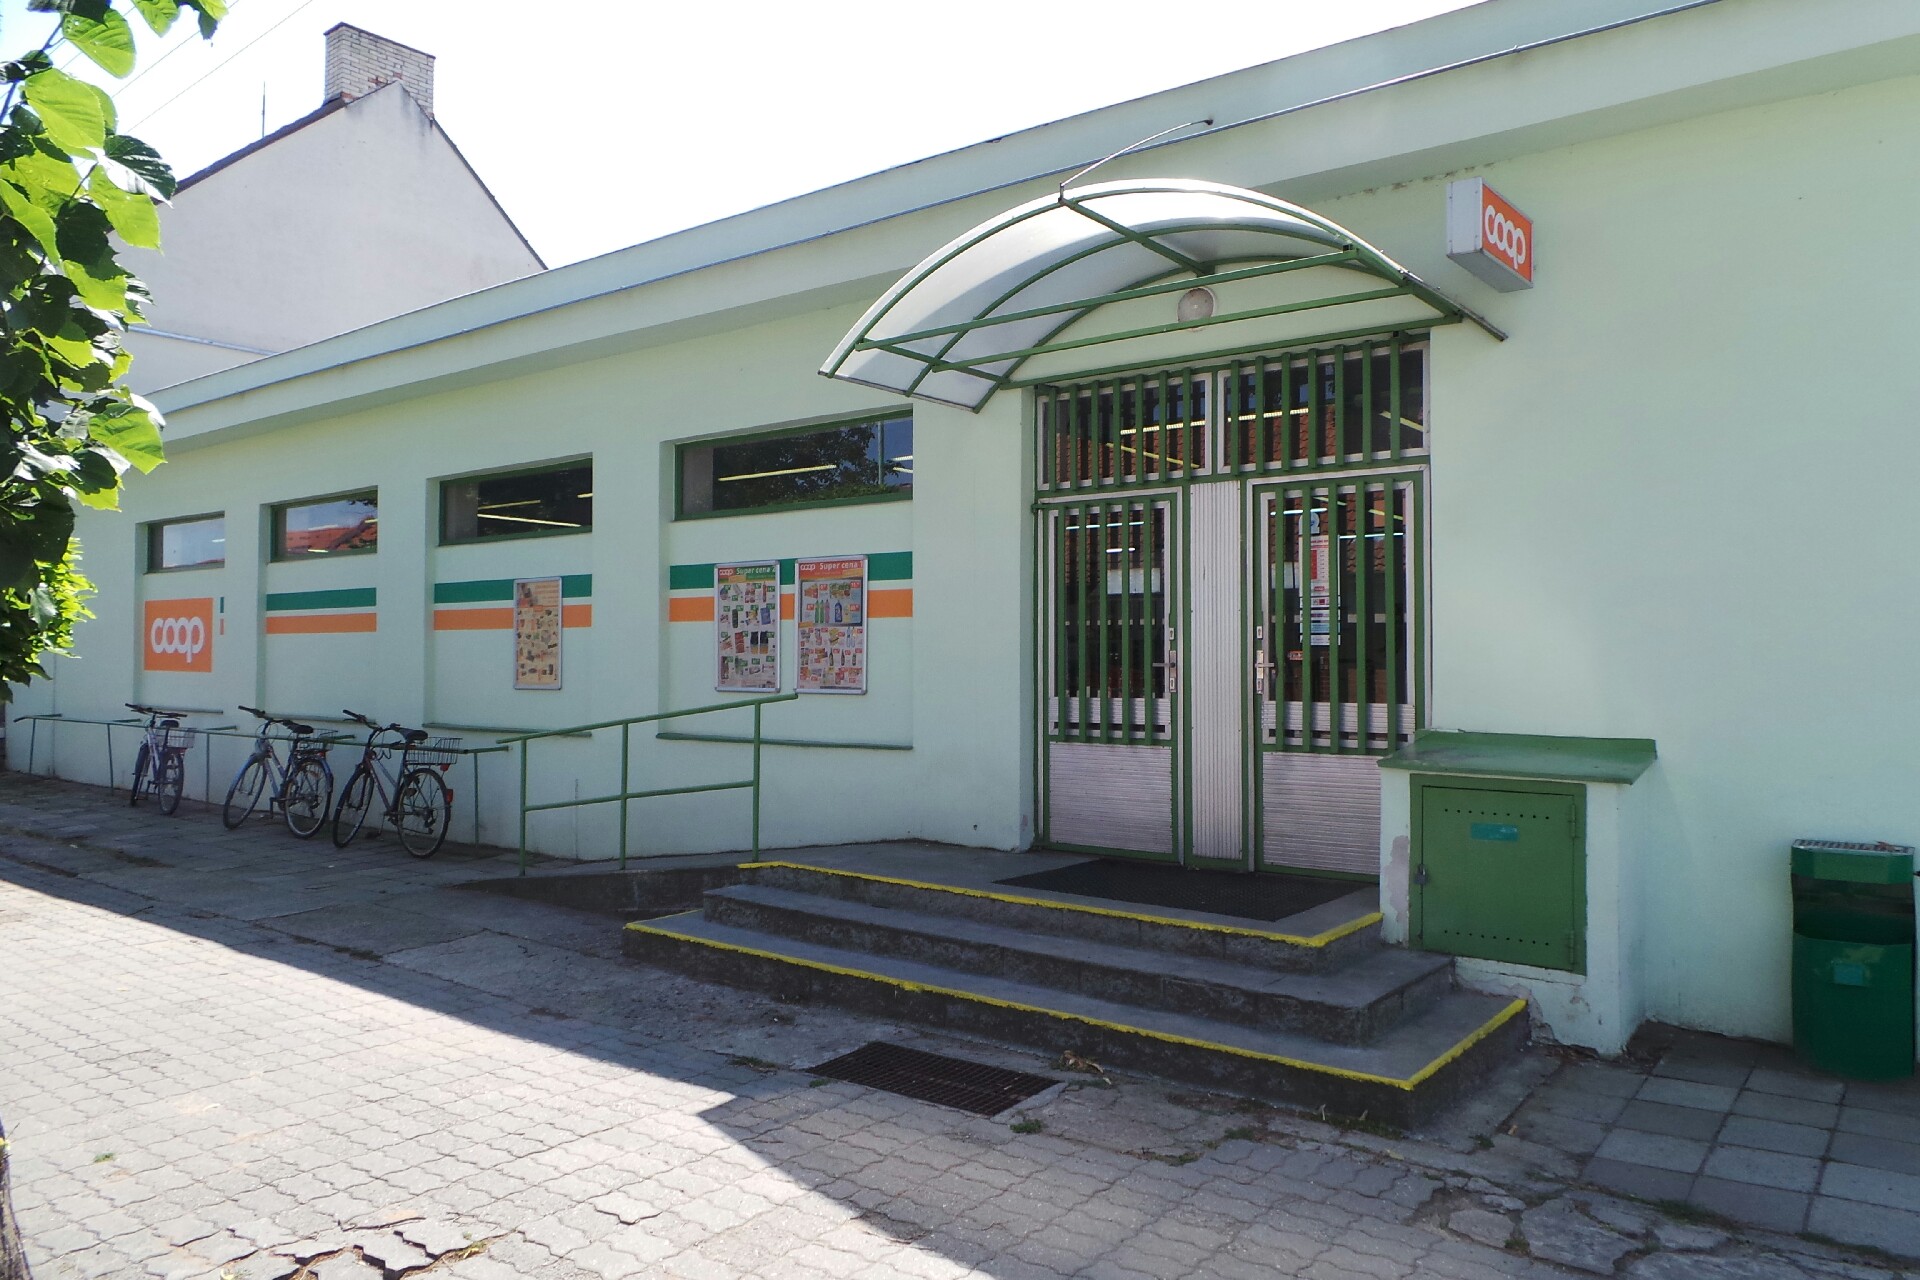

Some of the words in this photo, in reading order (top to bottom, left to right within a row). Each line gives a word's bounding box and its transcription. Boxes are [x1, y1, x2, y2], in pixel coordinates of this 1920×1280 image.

[1485, 204, 1526, 269] coop
[736, 567, 754, 575] Super
[819, 562, 839, 571] Super
[841, 561, 858, 569] cena
[151, 616, 204, 663] coop
